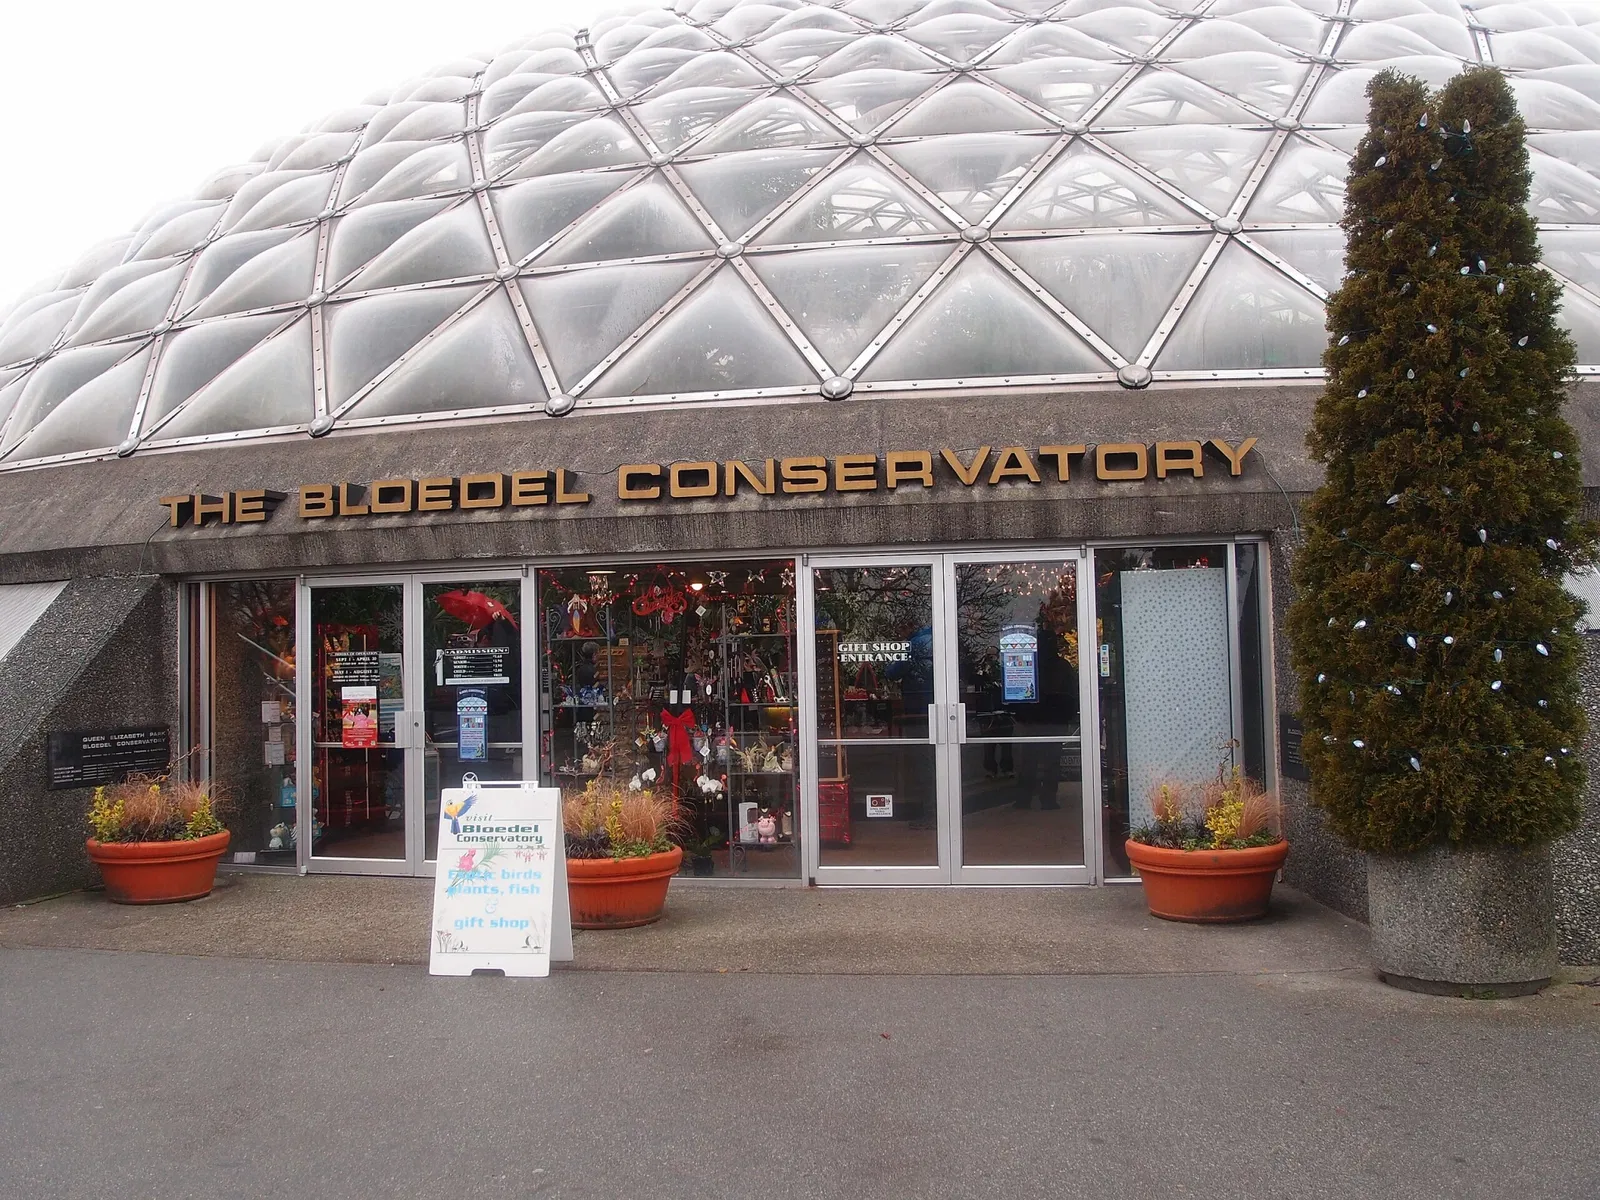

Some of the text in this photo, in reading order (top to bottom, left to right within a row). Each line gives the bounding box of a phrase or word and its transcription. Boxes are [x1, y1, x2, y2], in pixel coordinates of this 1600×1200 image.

[160, 438, 1258, 528] THE BLOEDEL CONSERVATORY
[838, 642, 910, 652] GIFT SHOP
[840, 653, 909, 662] ENTRANCE
[110, 732, 145, 741] ELIZABETH
[82, 742, 112, 750] BLOEDEL
[466, 813, 493, 822] visit
[462, 824, 539, 833] Bloedel
[456, 834, 543, 844] Conservatory
[448, 868, 543, 880] Etic birds
[448, 883, 541, 897] lants, fish
[454, 916, 530, 930] gift shop
